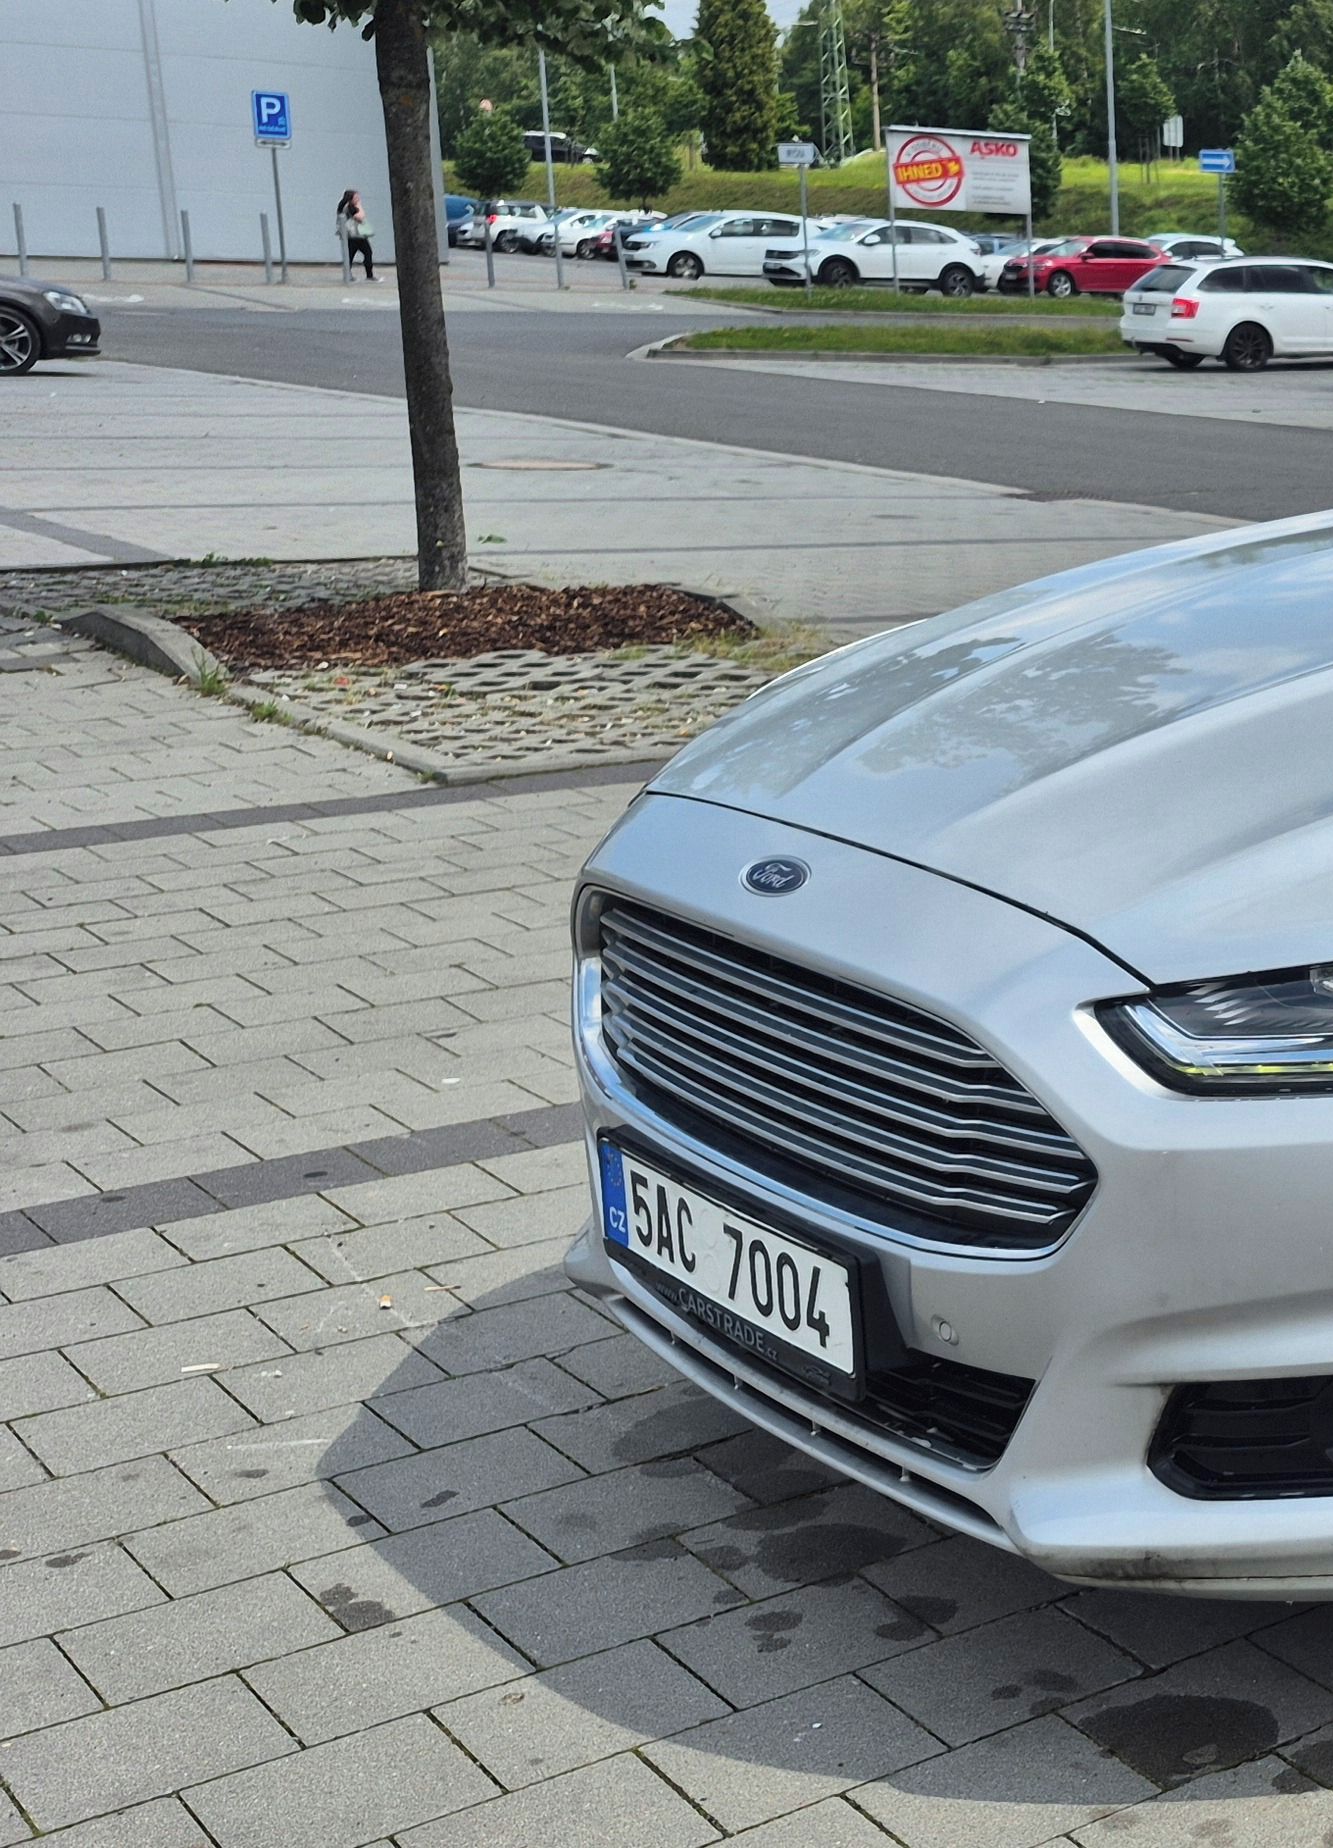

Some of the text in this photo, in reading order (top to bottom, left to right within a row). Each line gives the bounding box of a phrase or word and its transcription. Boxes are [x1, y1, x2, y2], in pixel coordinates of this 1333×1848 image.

[261, 97, 281, 123] P
[970, 142, 1018, 158] ASKO
[898, 164, 942, 181] IHNED
[752, 862, 794, 888] Ford
[609, 1206, 626, 1233] CZ
[630, 1169, 830, 1348] 5AC 7004
